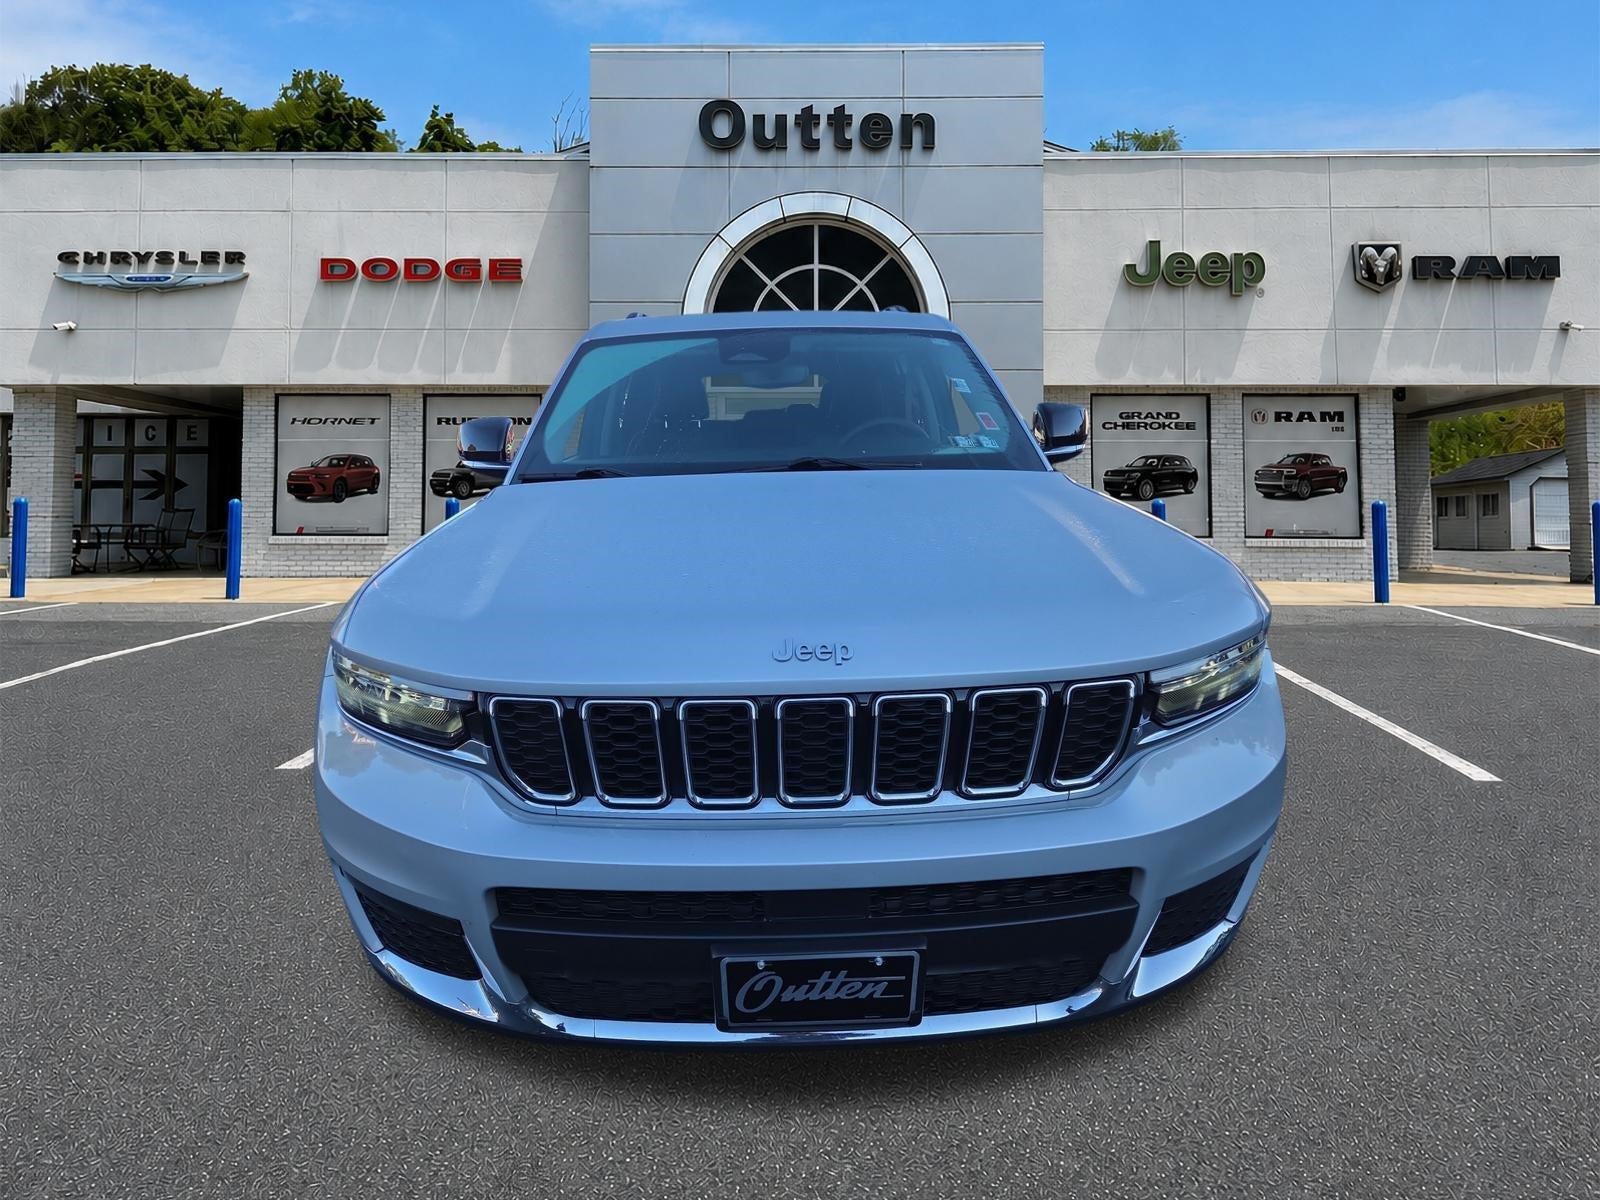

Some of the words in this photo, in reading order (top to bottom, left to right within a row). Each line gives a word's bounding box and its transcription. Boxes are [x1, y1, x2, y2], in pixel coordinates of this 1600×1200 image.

[699, 99, 936, 150] Outten
[56, 250, 247, 266] CHRYSLER
[320, 257, 523, 283] DODGE
[1123, 239, 1266, 296] Jeep
[1412, 255, 1561, 280] RAM
[290, 417, 381, 426] HORNET
[1101, 421, 1197, 431] CHEROKEE
[1118, 411, 1181, 420] GRAND
[1274, 410, 1345, 423] RAM
[771, 638, 854, 666] Jeep
[735, 970, 905, 1013] Outten
